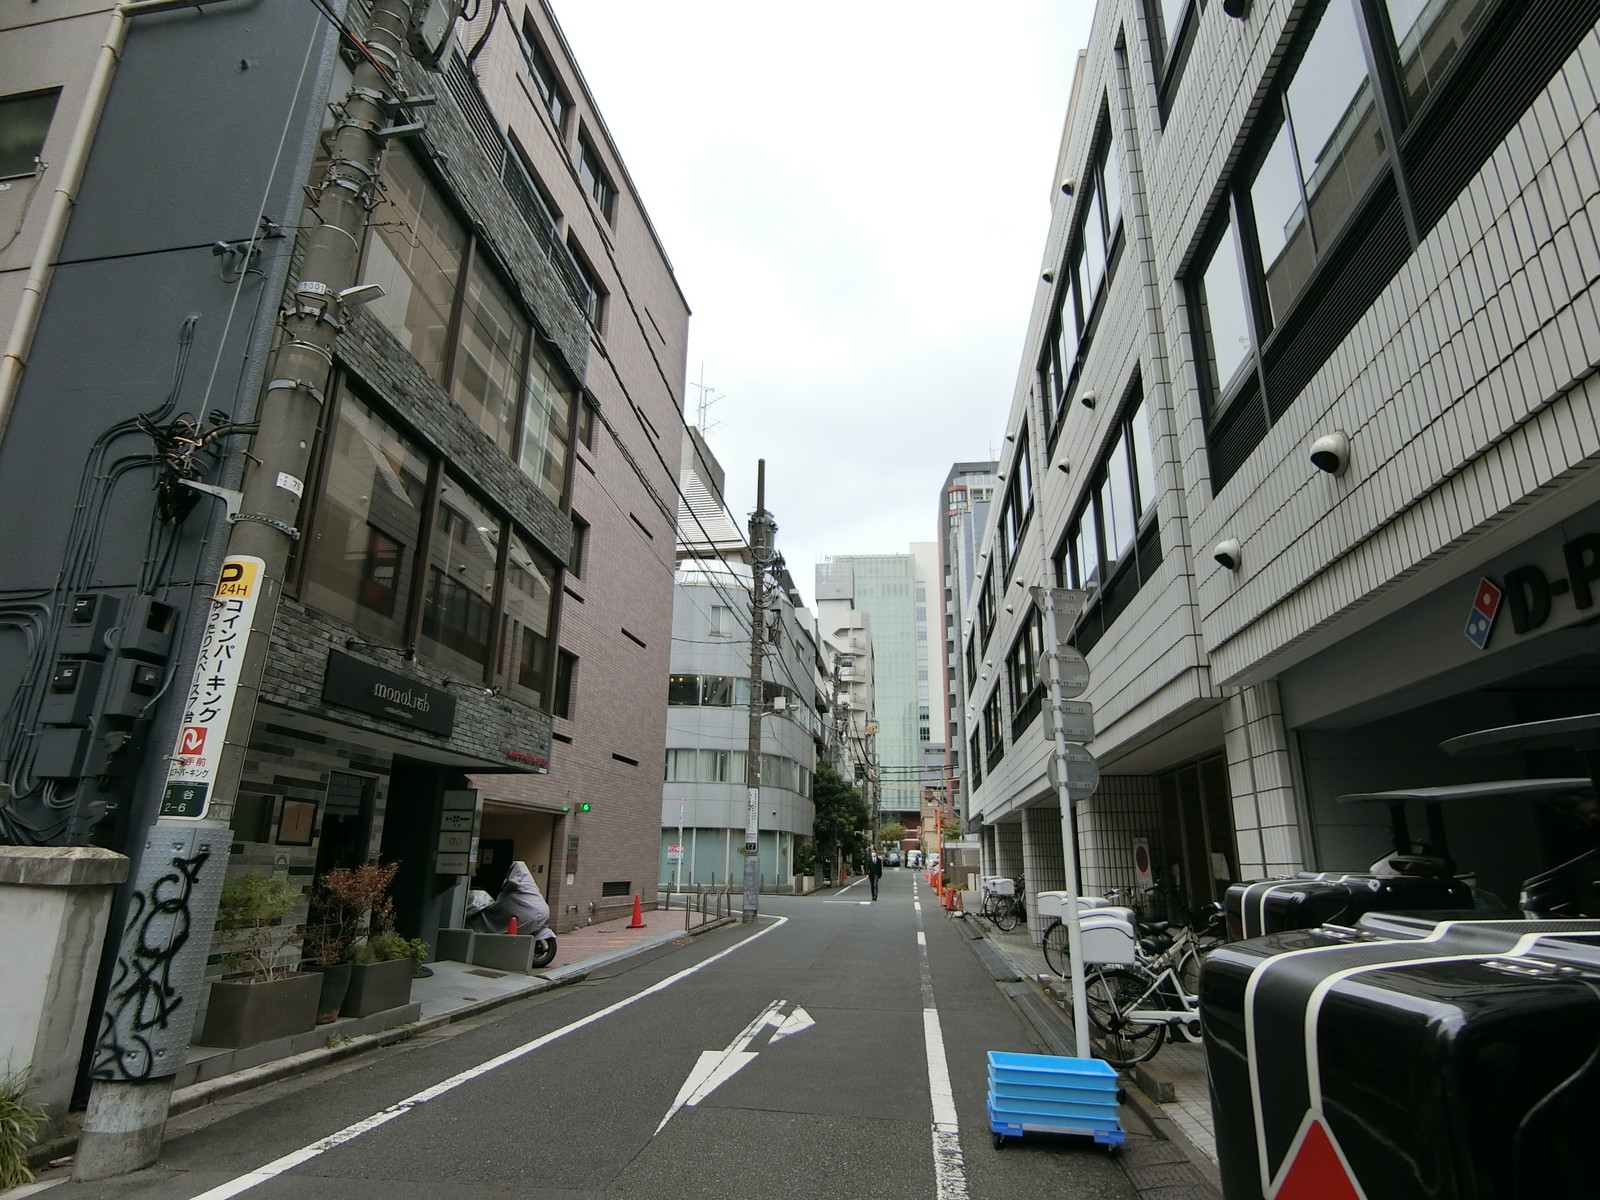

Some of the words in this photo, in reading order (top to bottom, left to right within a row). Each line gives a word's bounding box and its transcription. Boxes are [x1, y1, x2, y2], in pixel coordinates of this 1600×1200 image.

[216, 563, 244, 596] P
[220, 583, 248, 596] 24H
[199, 599, 244, 723] コインパーキング
[164, 802, 187, 813] 2-6
